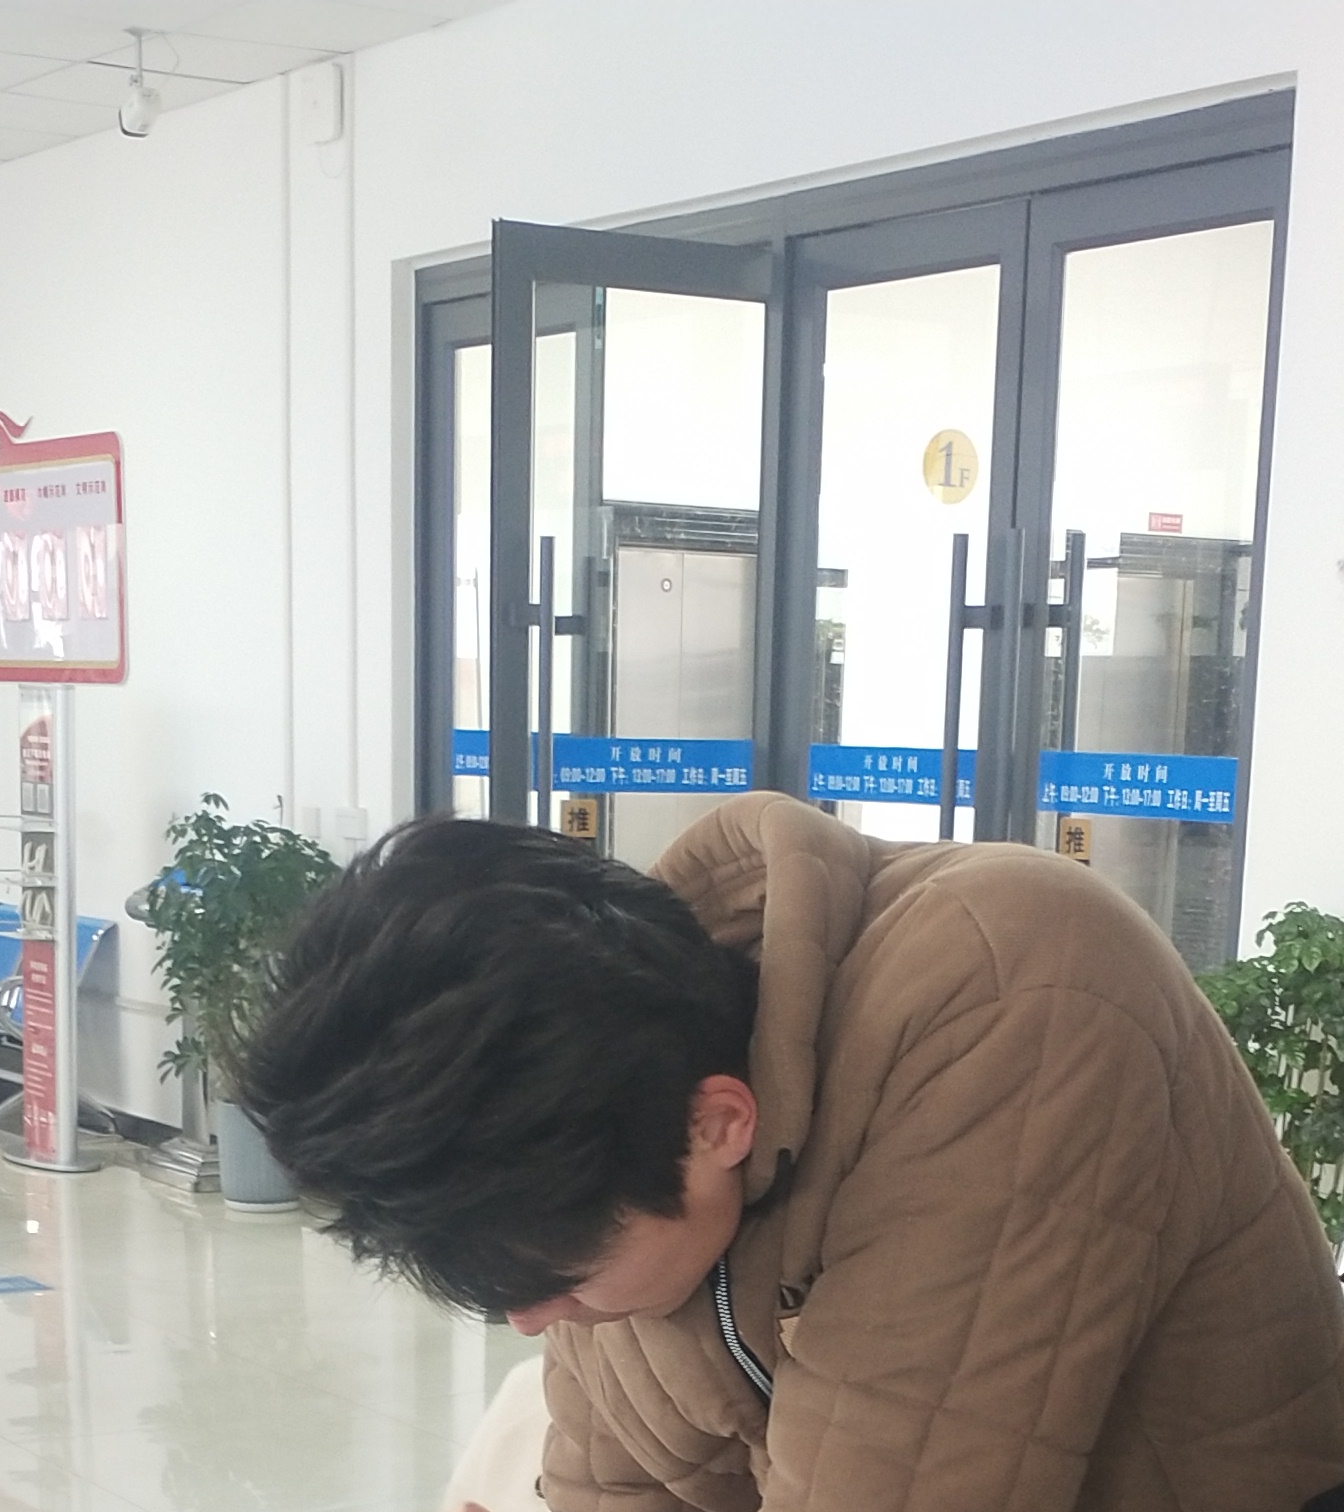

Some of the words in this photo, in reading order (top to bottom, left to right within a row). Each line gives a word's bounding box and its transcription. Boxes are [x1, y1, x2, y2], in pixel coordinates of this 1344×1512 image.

[610, 746, 683, 764] 开放时间
[1102, 763, 1169, 783] 开放时间
[567, 807, 591, 832] 推
